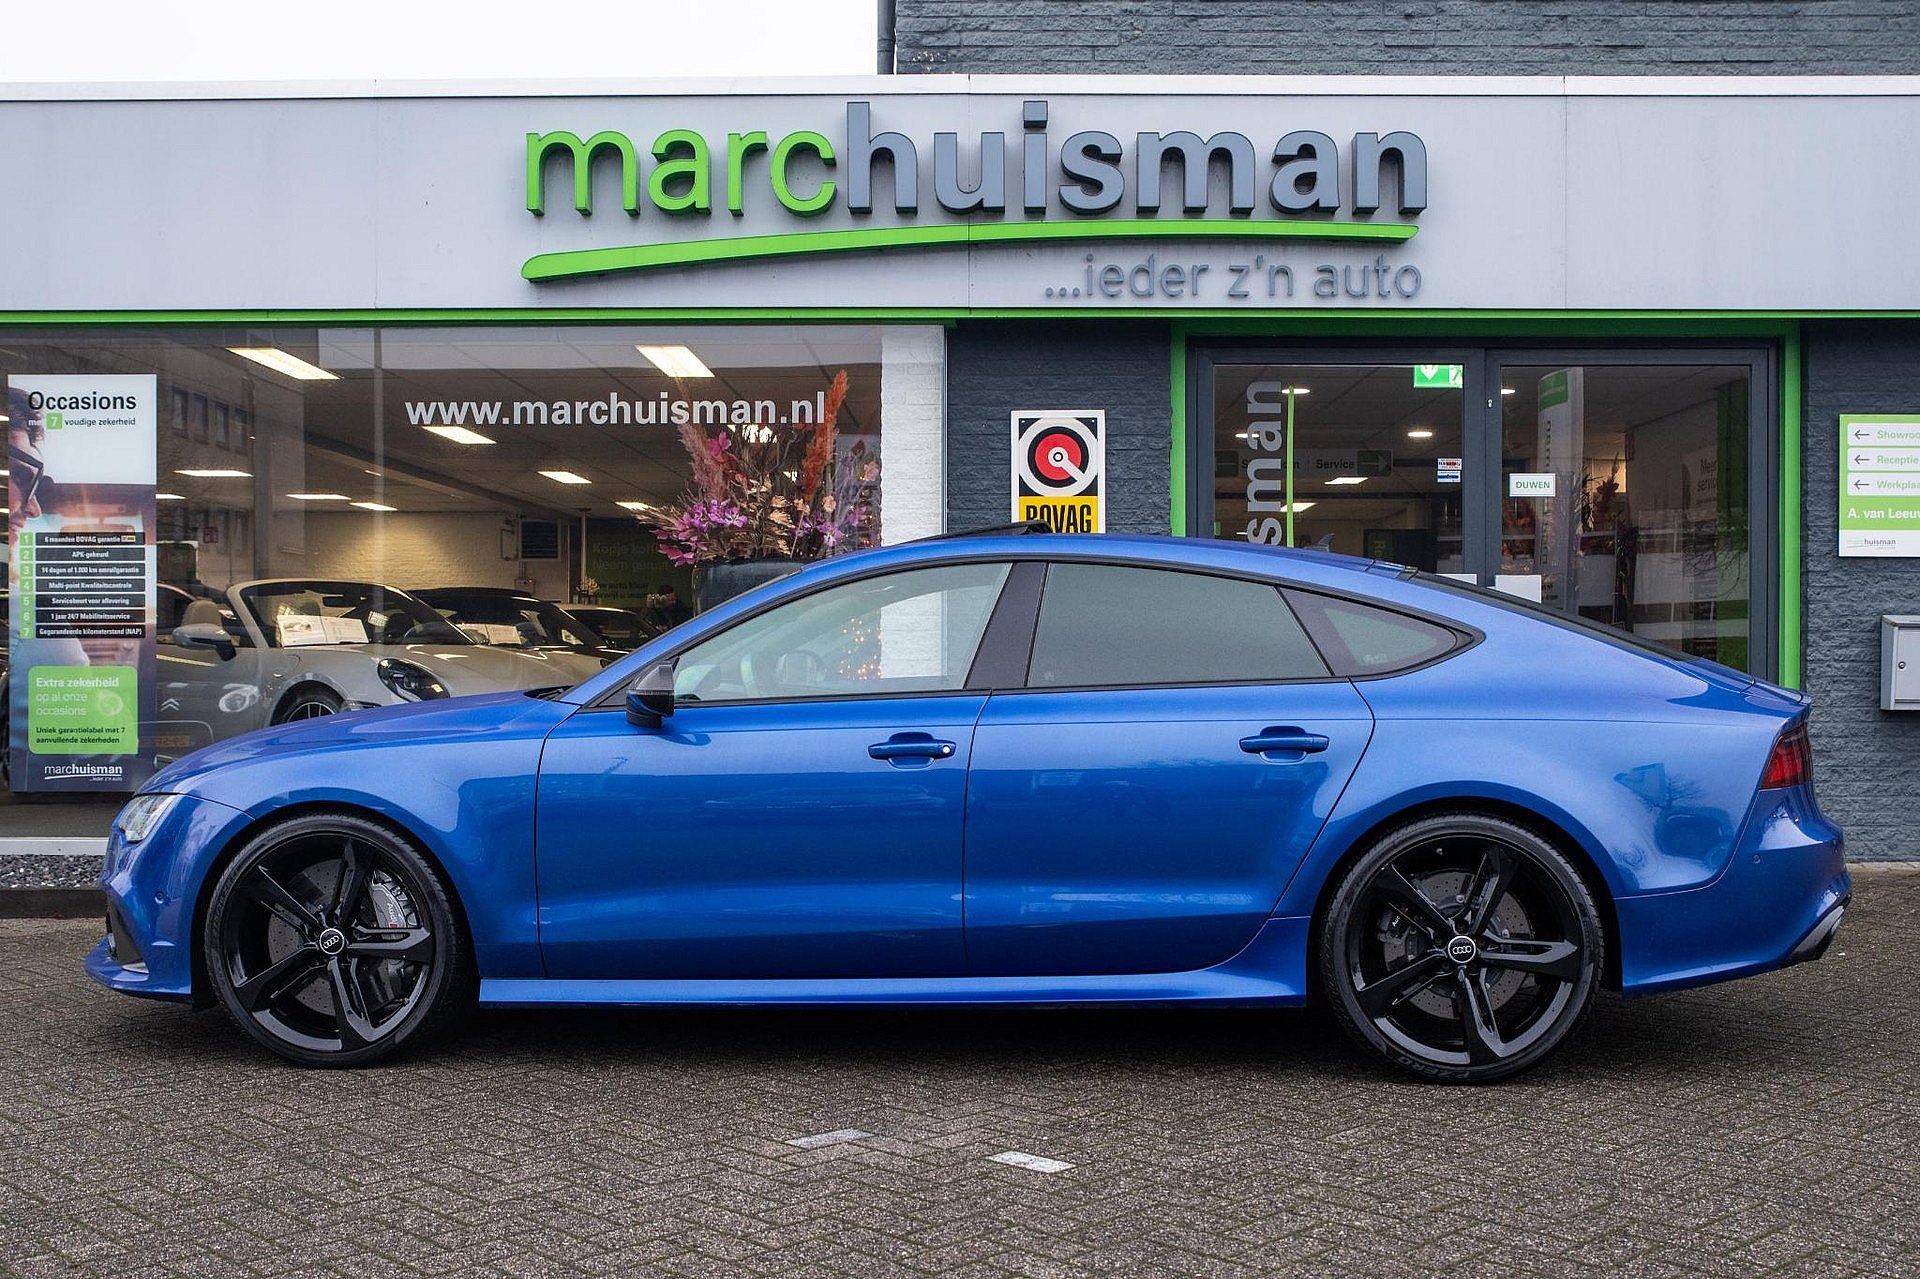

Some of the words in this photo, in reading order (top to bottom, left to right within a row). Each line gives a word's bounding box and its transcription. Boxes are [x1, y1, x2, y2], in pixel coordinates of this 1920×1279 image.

[525, 101, 1429, 218] marchuisman
[1045, 253, 1209, 298] ...ieder
[1227, 254, 1294, 298] z'n
[1313, 253, 1423, 298] auto
[28, 391, 137, 410] Occasions
[405, 391, 826, 425] www.marchuisman.nl
[50, 416, 58, 426] 7
[64, 418, 97, 428] voudige
[98, 417, 136, 426] zekerheid
[1315, 459, 1355, 470] Service
[1877, 455, 1919, 466] Receptie
[1515, 481, 1551, 489] DUWEN
[1847, 507, 1860, 519] A.
[1863, 510, 1885, 519] van
[36, 677, 65, 687] Extra
[67, 677, 120, 688] zekerheid
[44, 763, 123, 774] marchuisman
